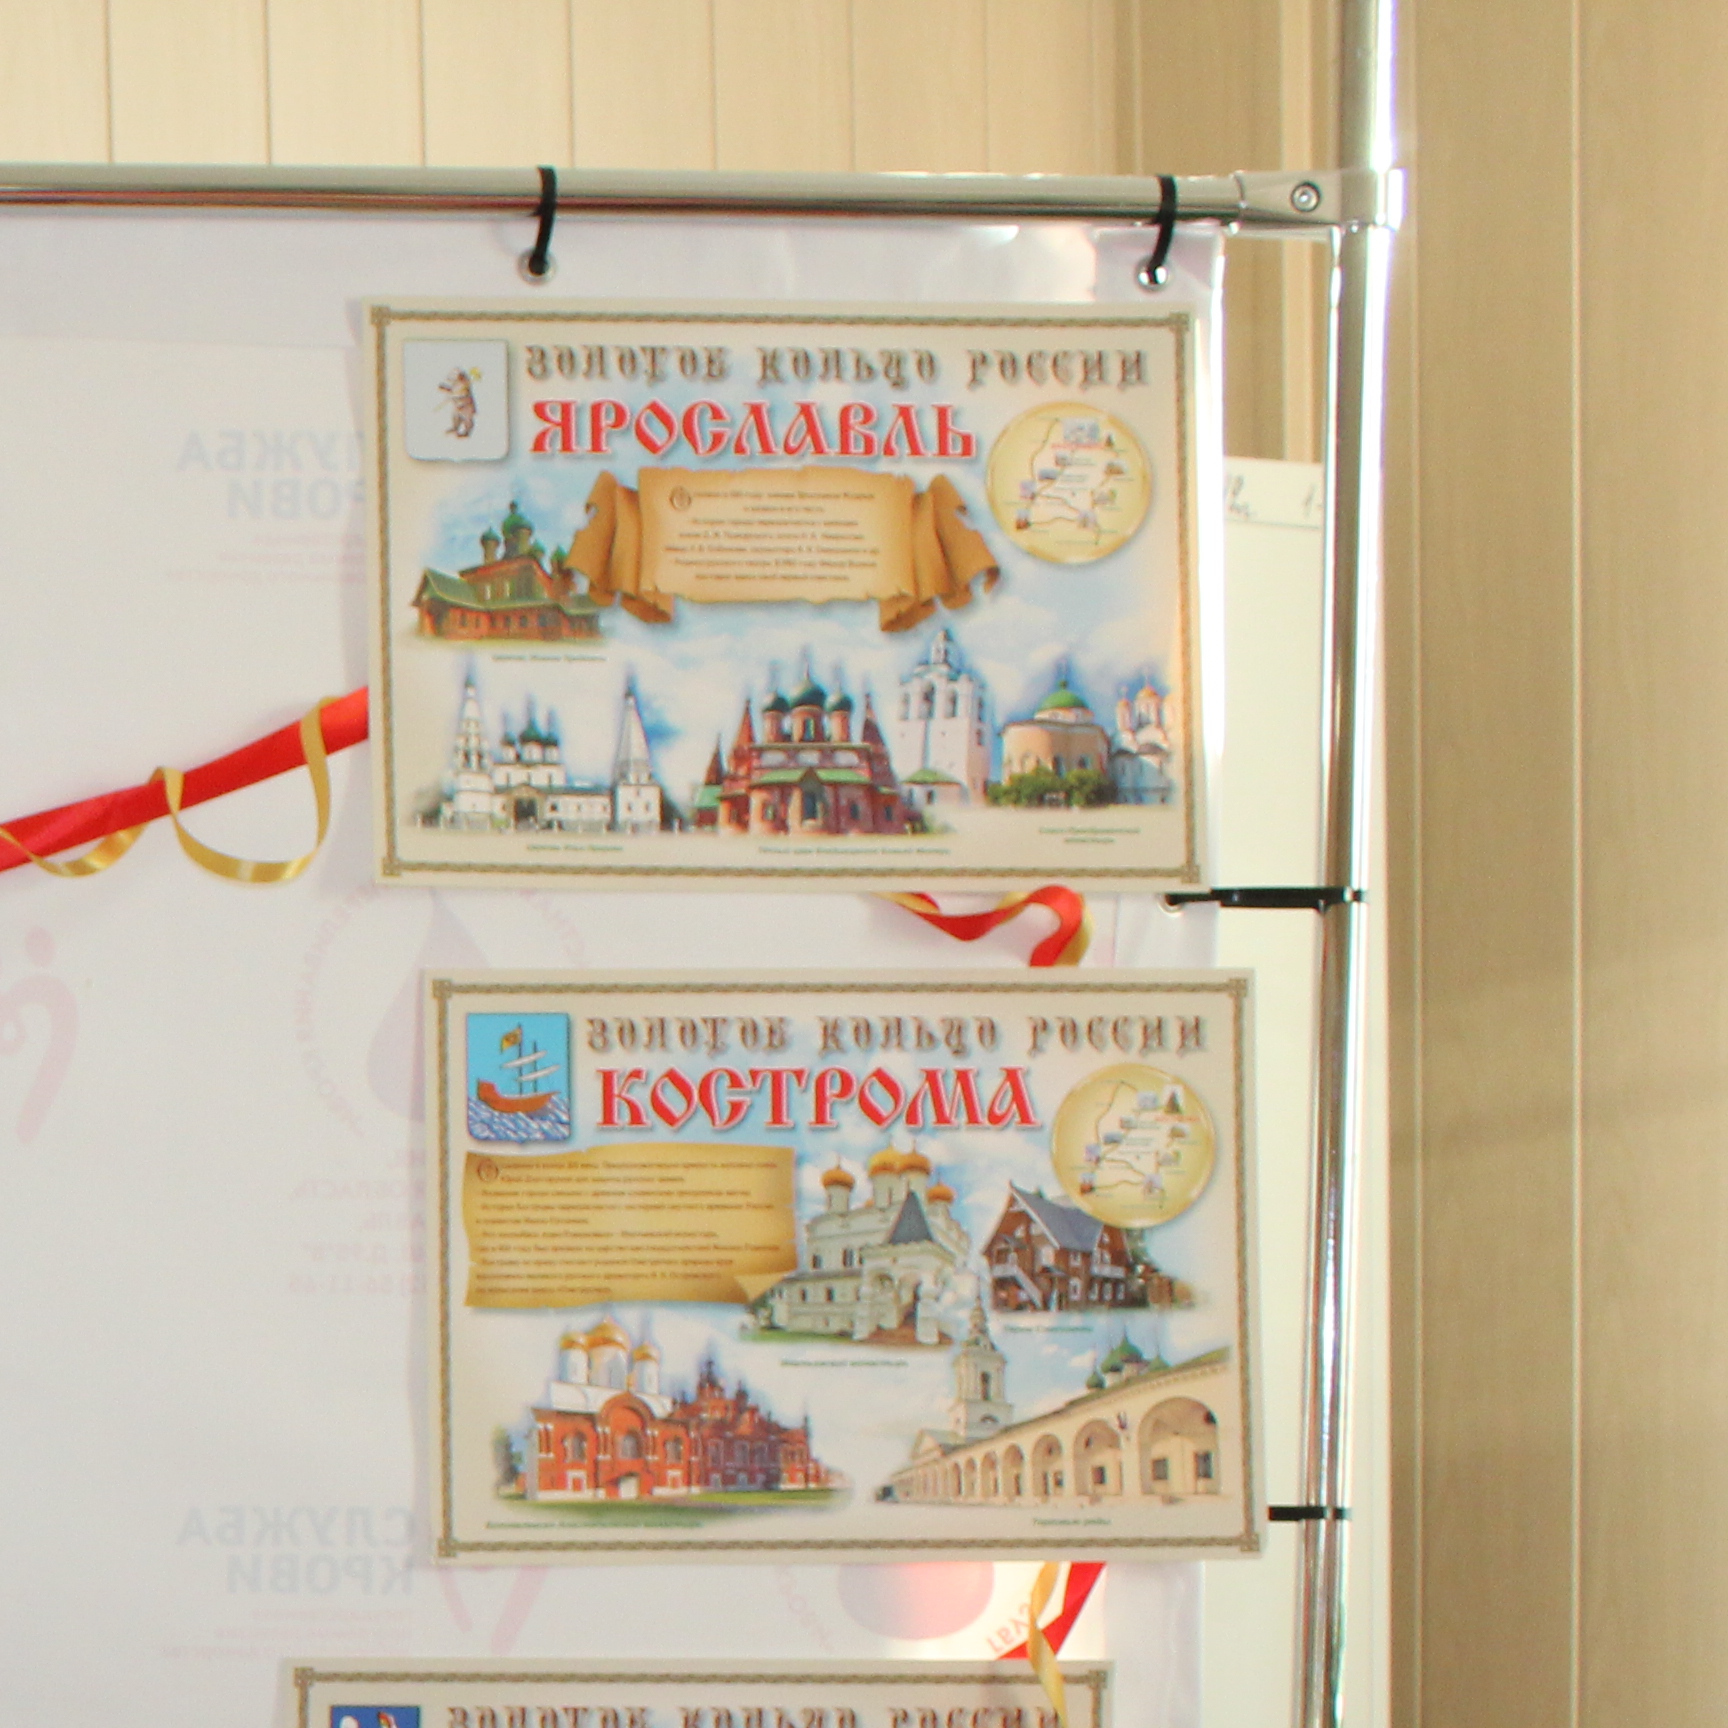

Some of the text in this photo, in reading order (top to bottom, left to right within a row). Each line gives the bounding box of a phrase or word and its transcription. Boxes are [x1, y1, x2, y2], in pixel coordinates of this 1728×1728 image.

[526, 345, 1150, 391] ЗОЛОТОЕ КОЛЬЦО РОССИИ
[530, 399, 978, 458] ЯРОСЛАВЛЬ
[587, 1015, 1208, 1058] ЗОЛОТОЕ КОЛЬЦО РОССИИ
[597, 1066, 1041, 1130] КОСТРОМА
